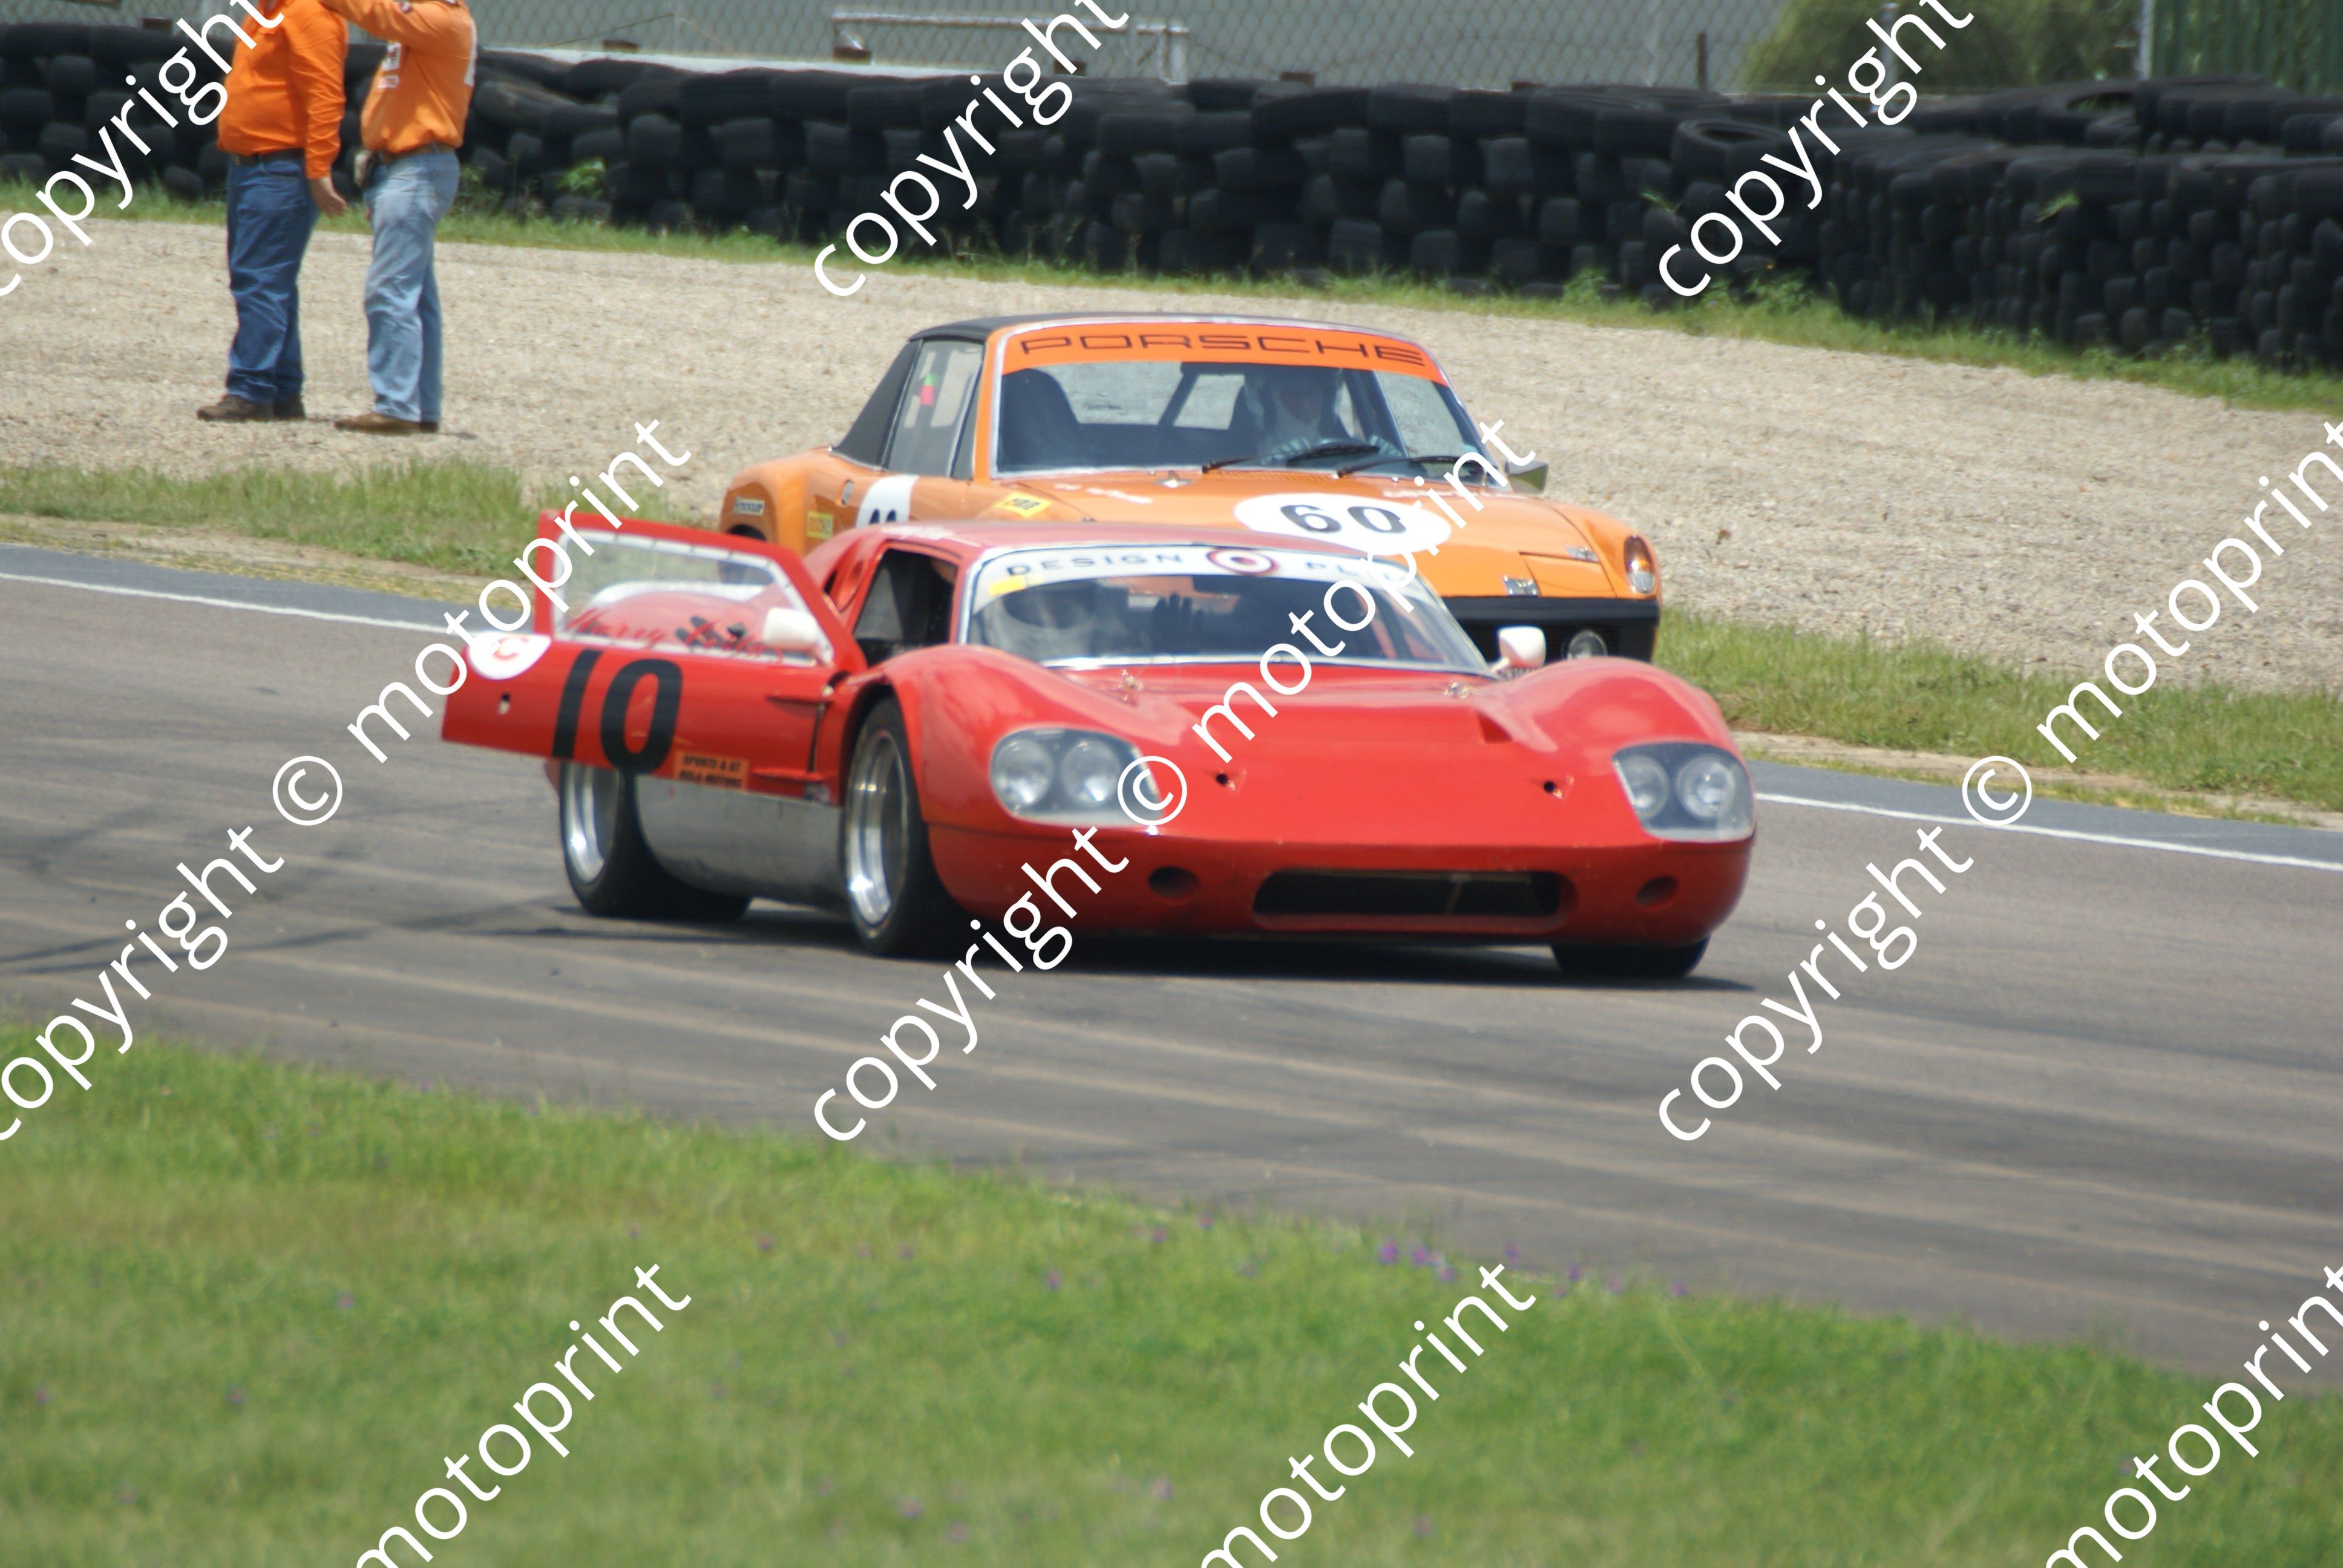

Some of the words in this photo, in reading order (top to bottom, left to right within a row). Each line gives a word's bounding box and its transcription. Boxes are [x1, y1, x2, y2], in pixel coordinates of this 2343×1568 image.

[1021, 334, 1426, 367] PORSCHE
[1280, 504, 1407, 534] 60
[1006, 554, 1182, 576] DESIGN
[551, 648, 684, 775] 10
